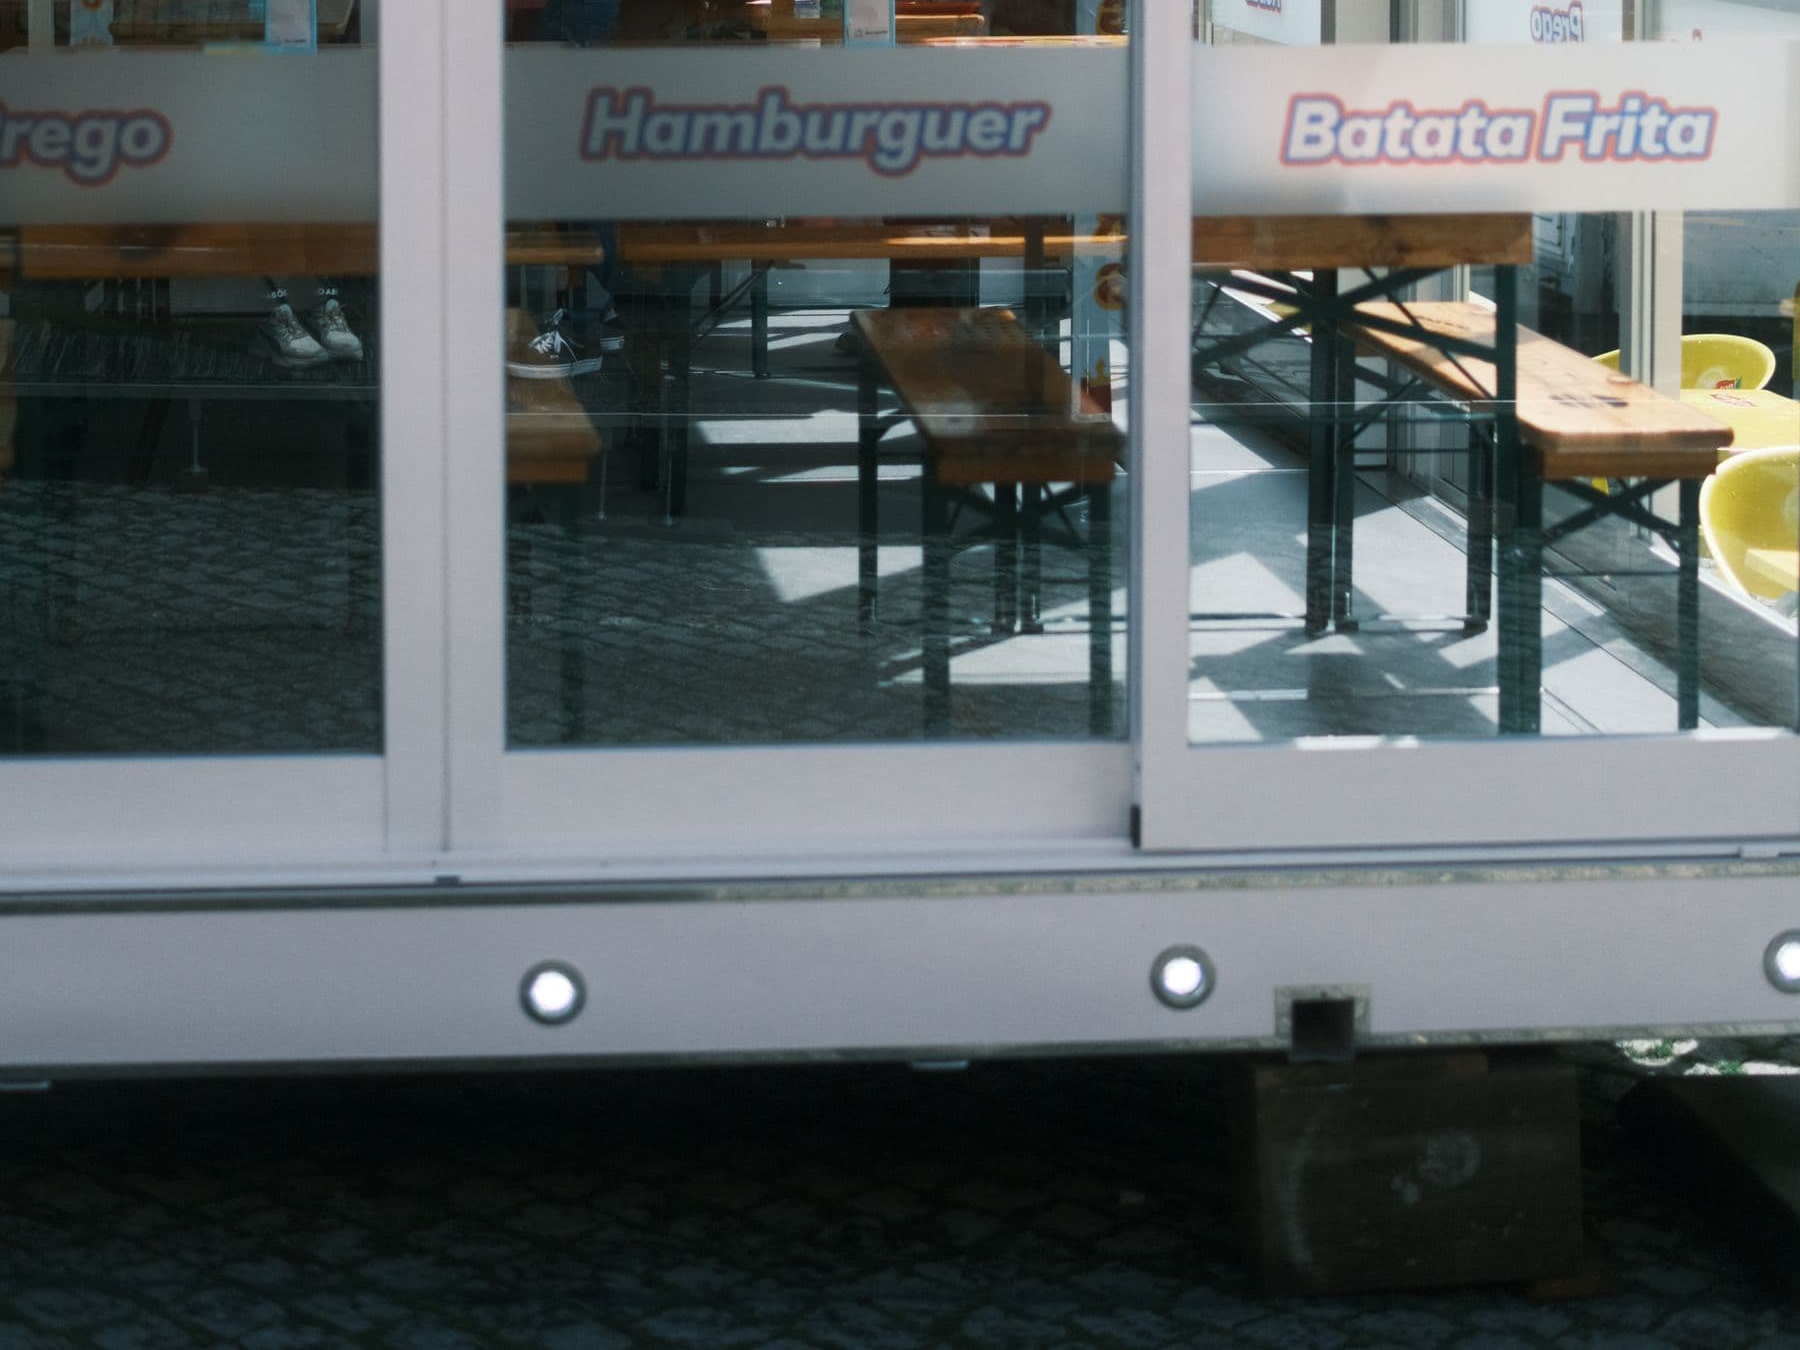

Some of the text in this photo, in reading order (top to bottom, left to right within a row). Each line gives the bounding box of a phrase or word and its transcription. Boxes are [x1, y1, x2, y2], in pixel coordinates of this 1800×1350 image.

[0, 102, 173, 187] rego
[580, 86, 1052, 178] Hamburguer
[1280, 90, 1718, 167] Batata Frita
